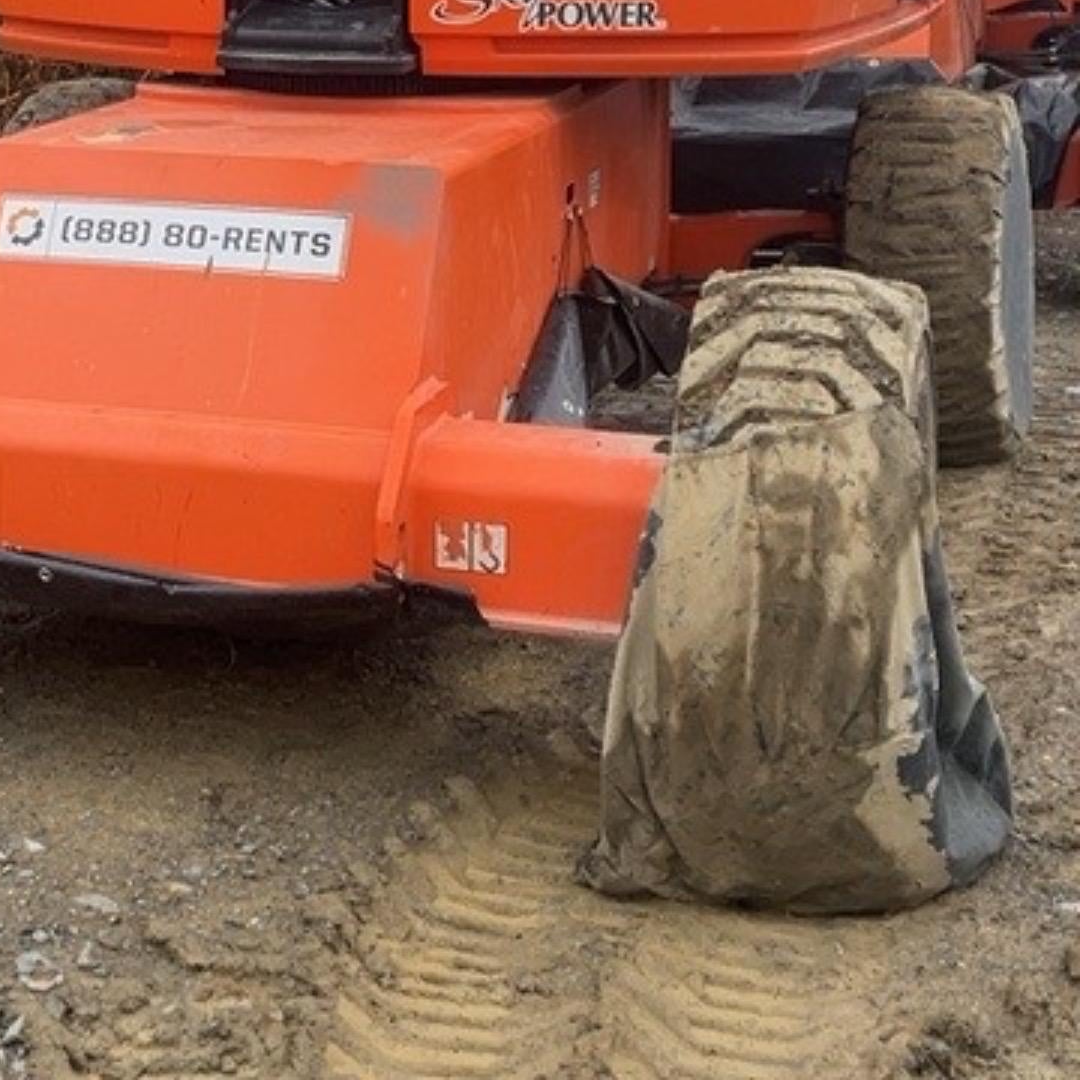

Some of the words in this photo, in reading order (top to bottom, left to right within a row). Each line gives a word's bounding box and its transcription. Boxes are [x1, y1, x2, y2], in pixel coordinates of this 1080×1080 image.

[533, 0, 660, 29] POWER
[60, 215, 152, 248] (888)
[162, 223, 333, 258] 80-RENTS
